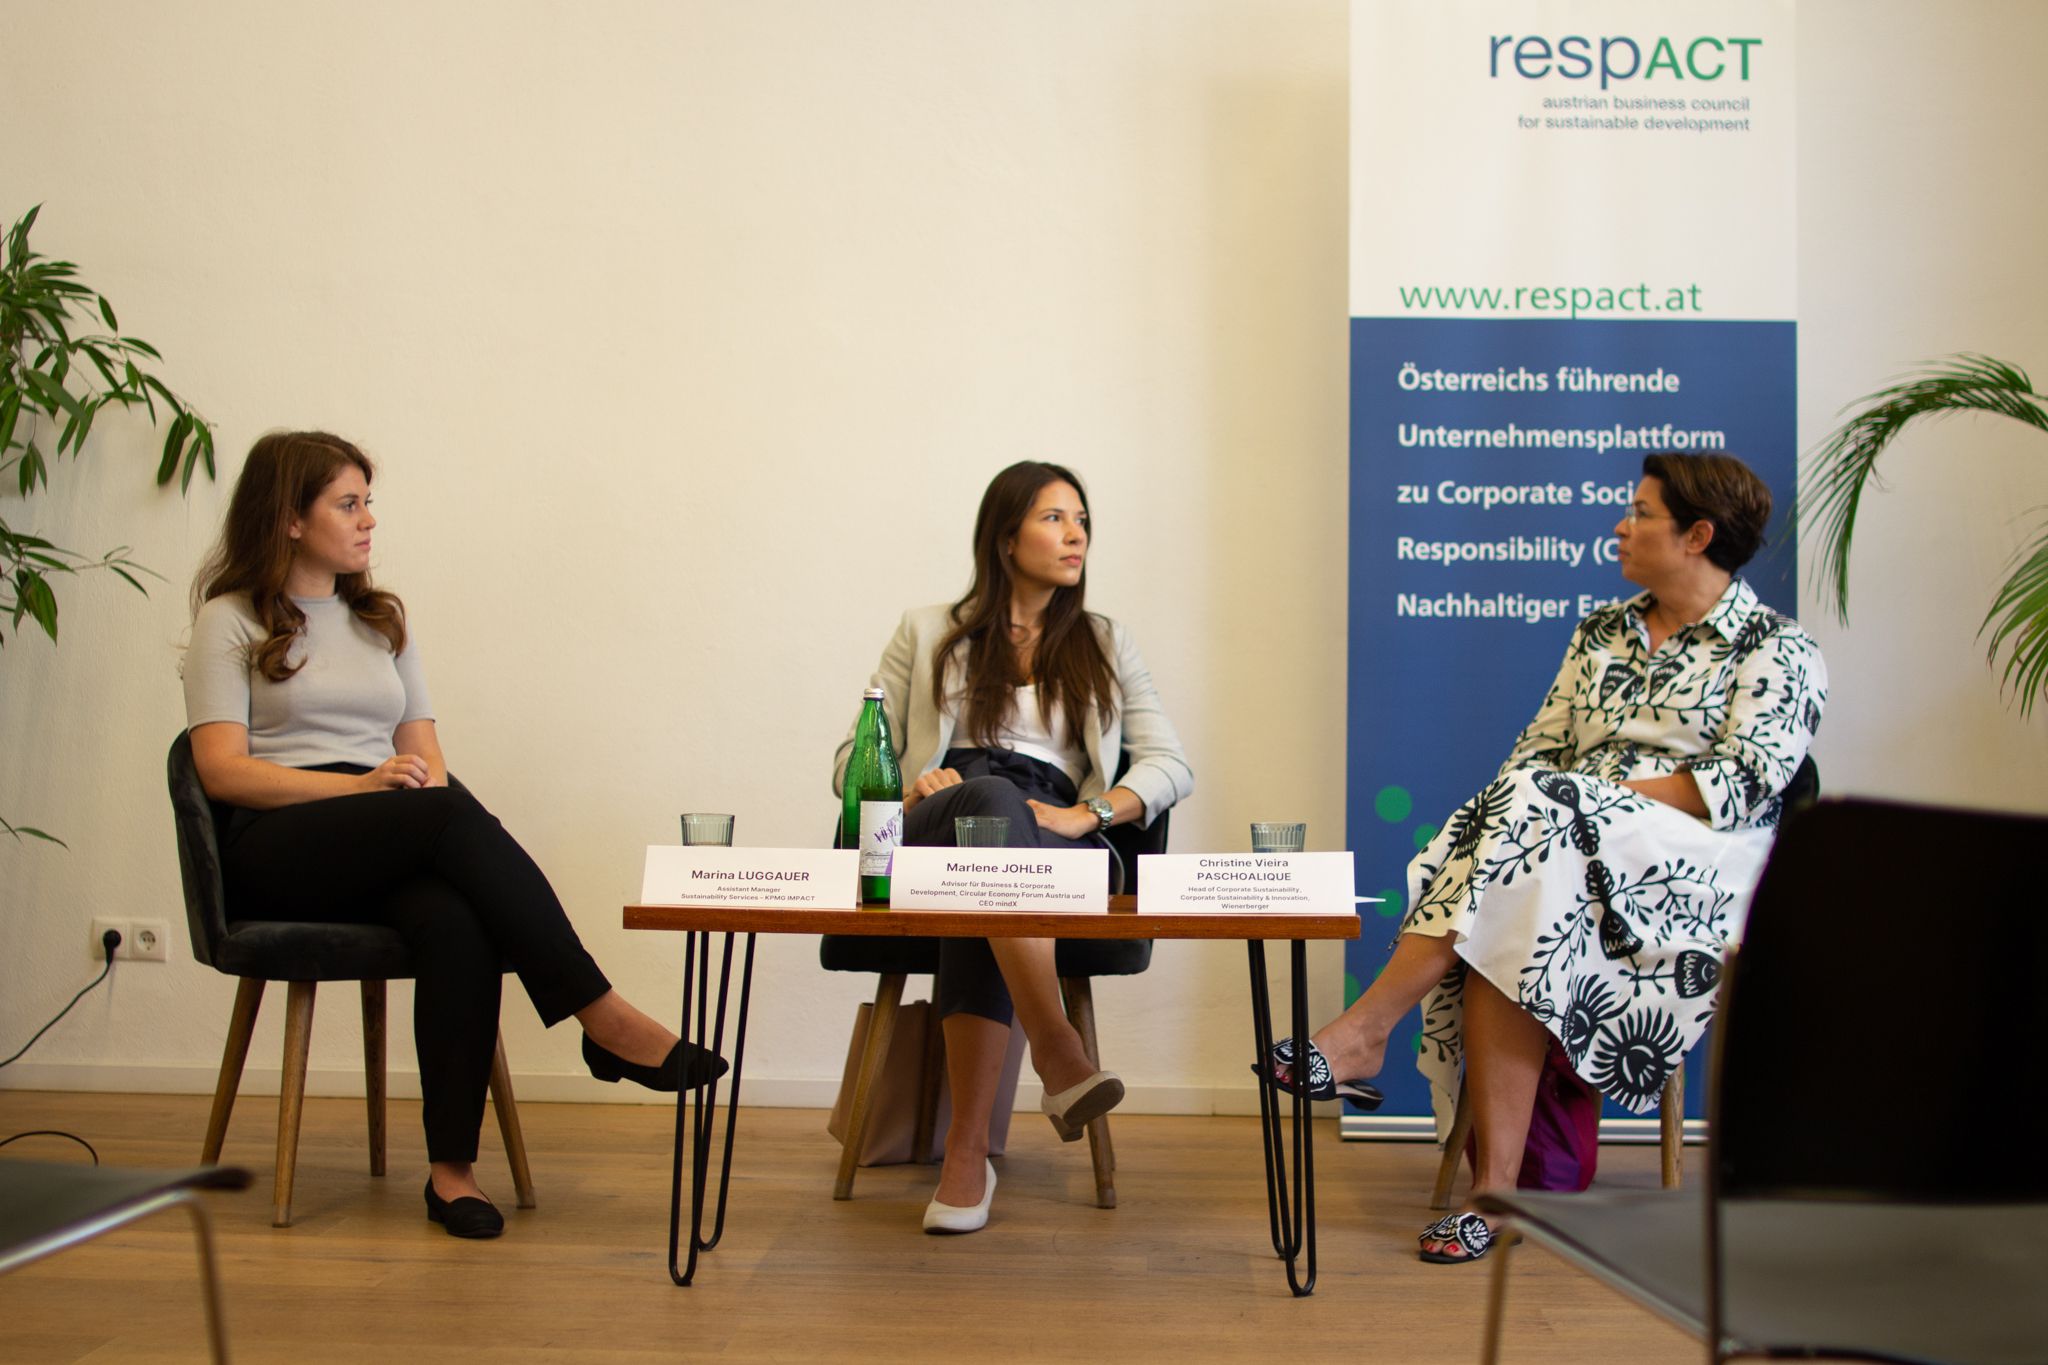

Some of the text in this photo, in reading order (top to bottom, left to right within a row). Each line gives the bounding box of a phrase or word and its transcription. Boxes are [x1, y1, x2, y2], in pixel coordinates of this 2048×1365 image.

[1490, 34, 1762, 90] respACT
[1543, 96, 1750, 112] austrian business council
[1518, 115, 1750, 133] for sustainable development
[1399, 282, 1703, 319] www.respact.at
[1398, 362, 1680, 393] Österreichs führende
[1398, 424, 1725, 453] Unternehmensplattform
[1397, 481, 1634, 509] zu Corporate Soci
[1398, 537, 1585, 566] Responsibility
[1397, 593, 1569, 623] Nachhaltiger
[947, 863, 1052, 874] Marlene JOHLER
[1200, 859, 1288, 867] Christine Vieira
[692, 870, 809, 881] Marina LUGGAUER
[1197, 873, 1291, 881] PASCHOALIQUE
[989, 891, 1019, 899] Economy
